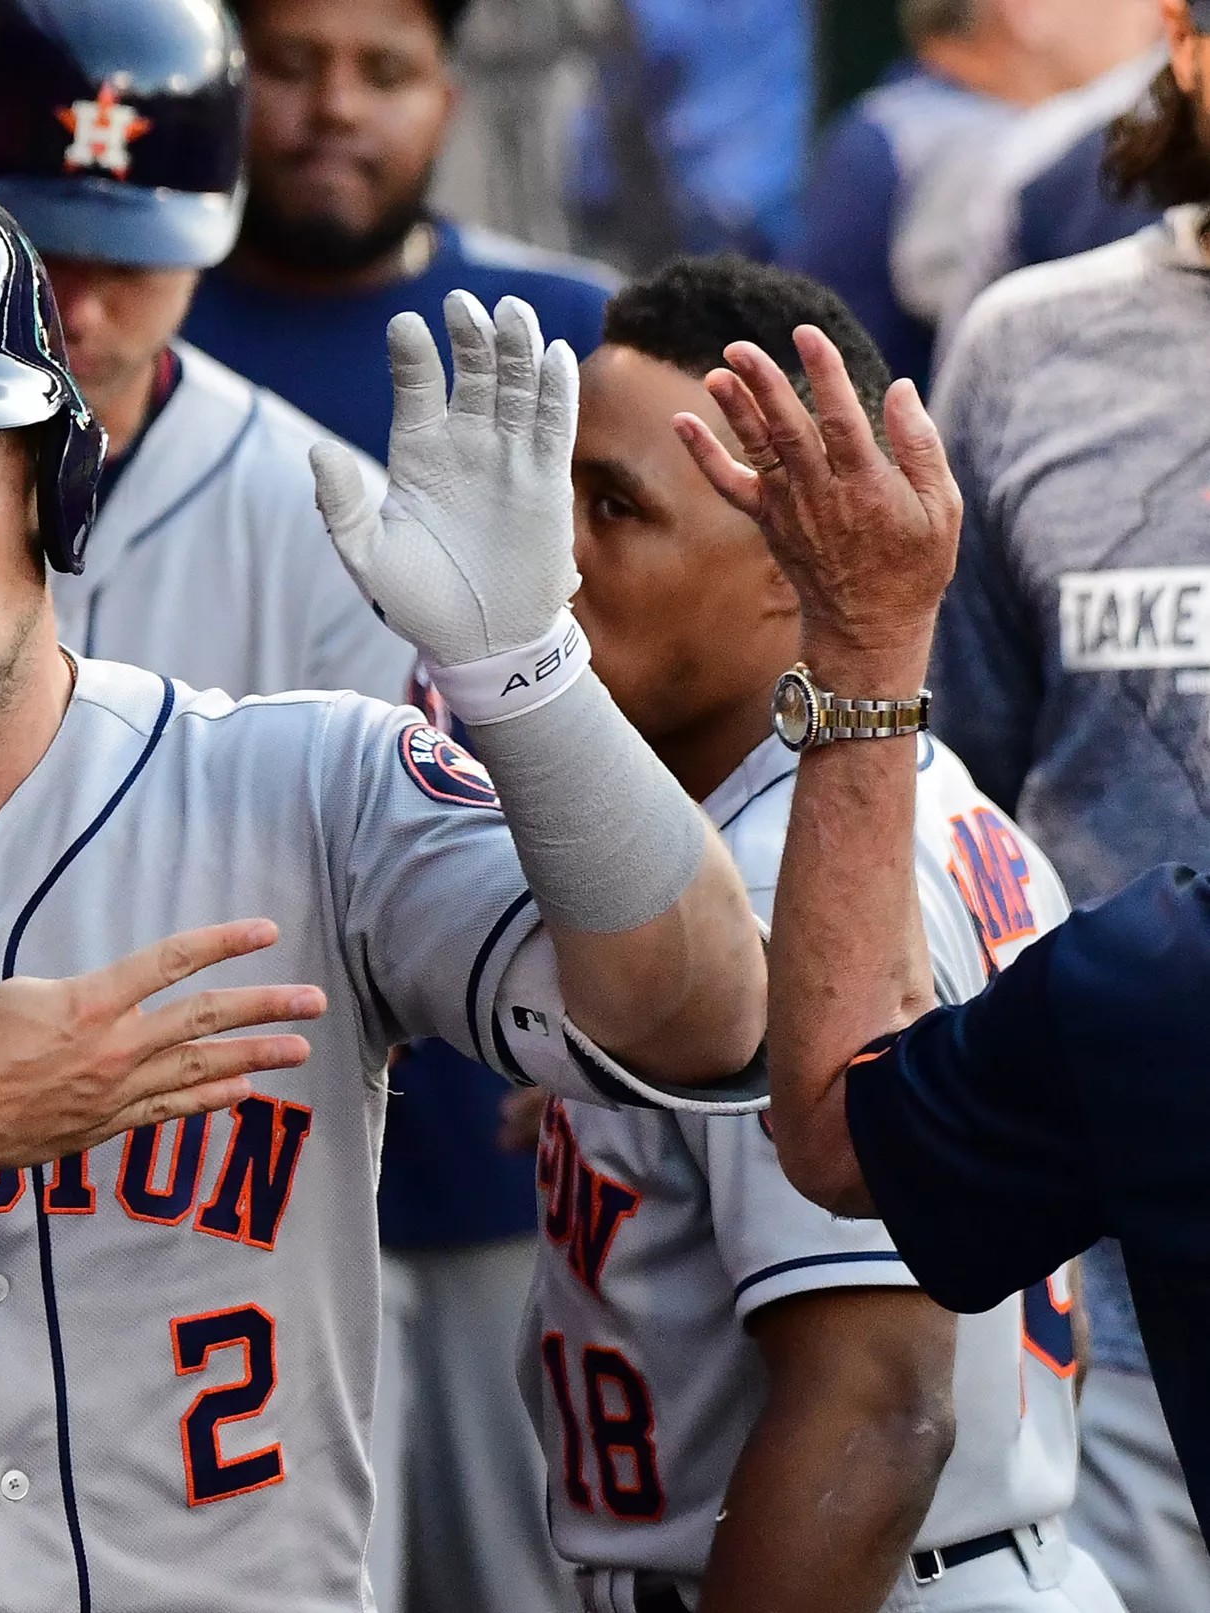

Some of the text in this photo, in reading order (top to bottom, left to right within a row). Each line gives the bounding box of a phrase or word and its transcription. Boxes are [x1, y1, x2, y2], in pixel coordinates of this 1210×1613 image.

[65, 99, 139, 169] H
[1071, 583, 1202, 656] TAKE
[169, 1302, 284, 1507] 2
[541, 1330, 666, 1523] 18
